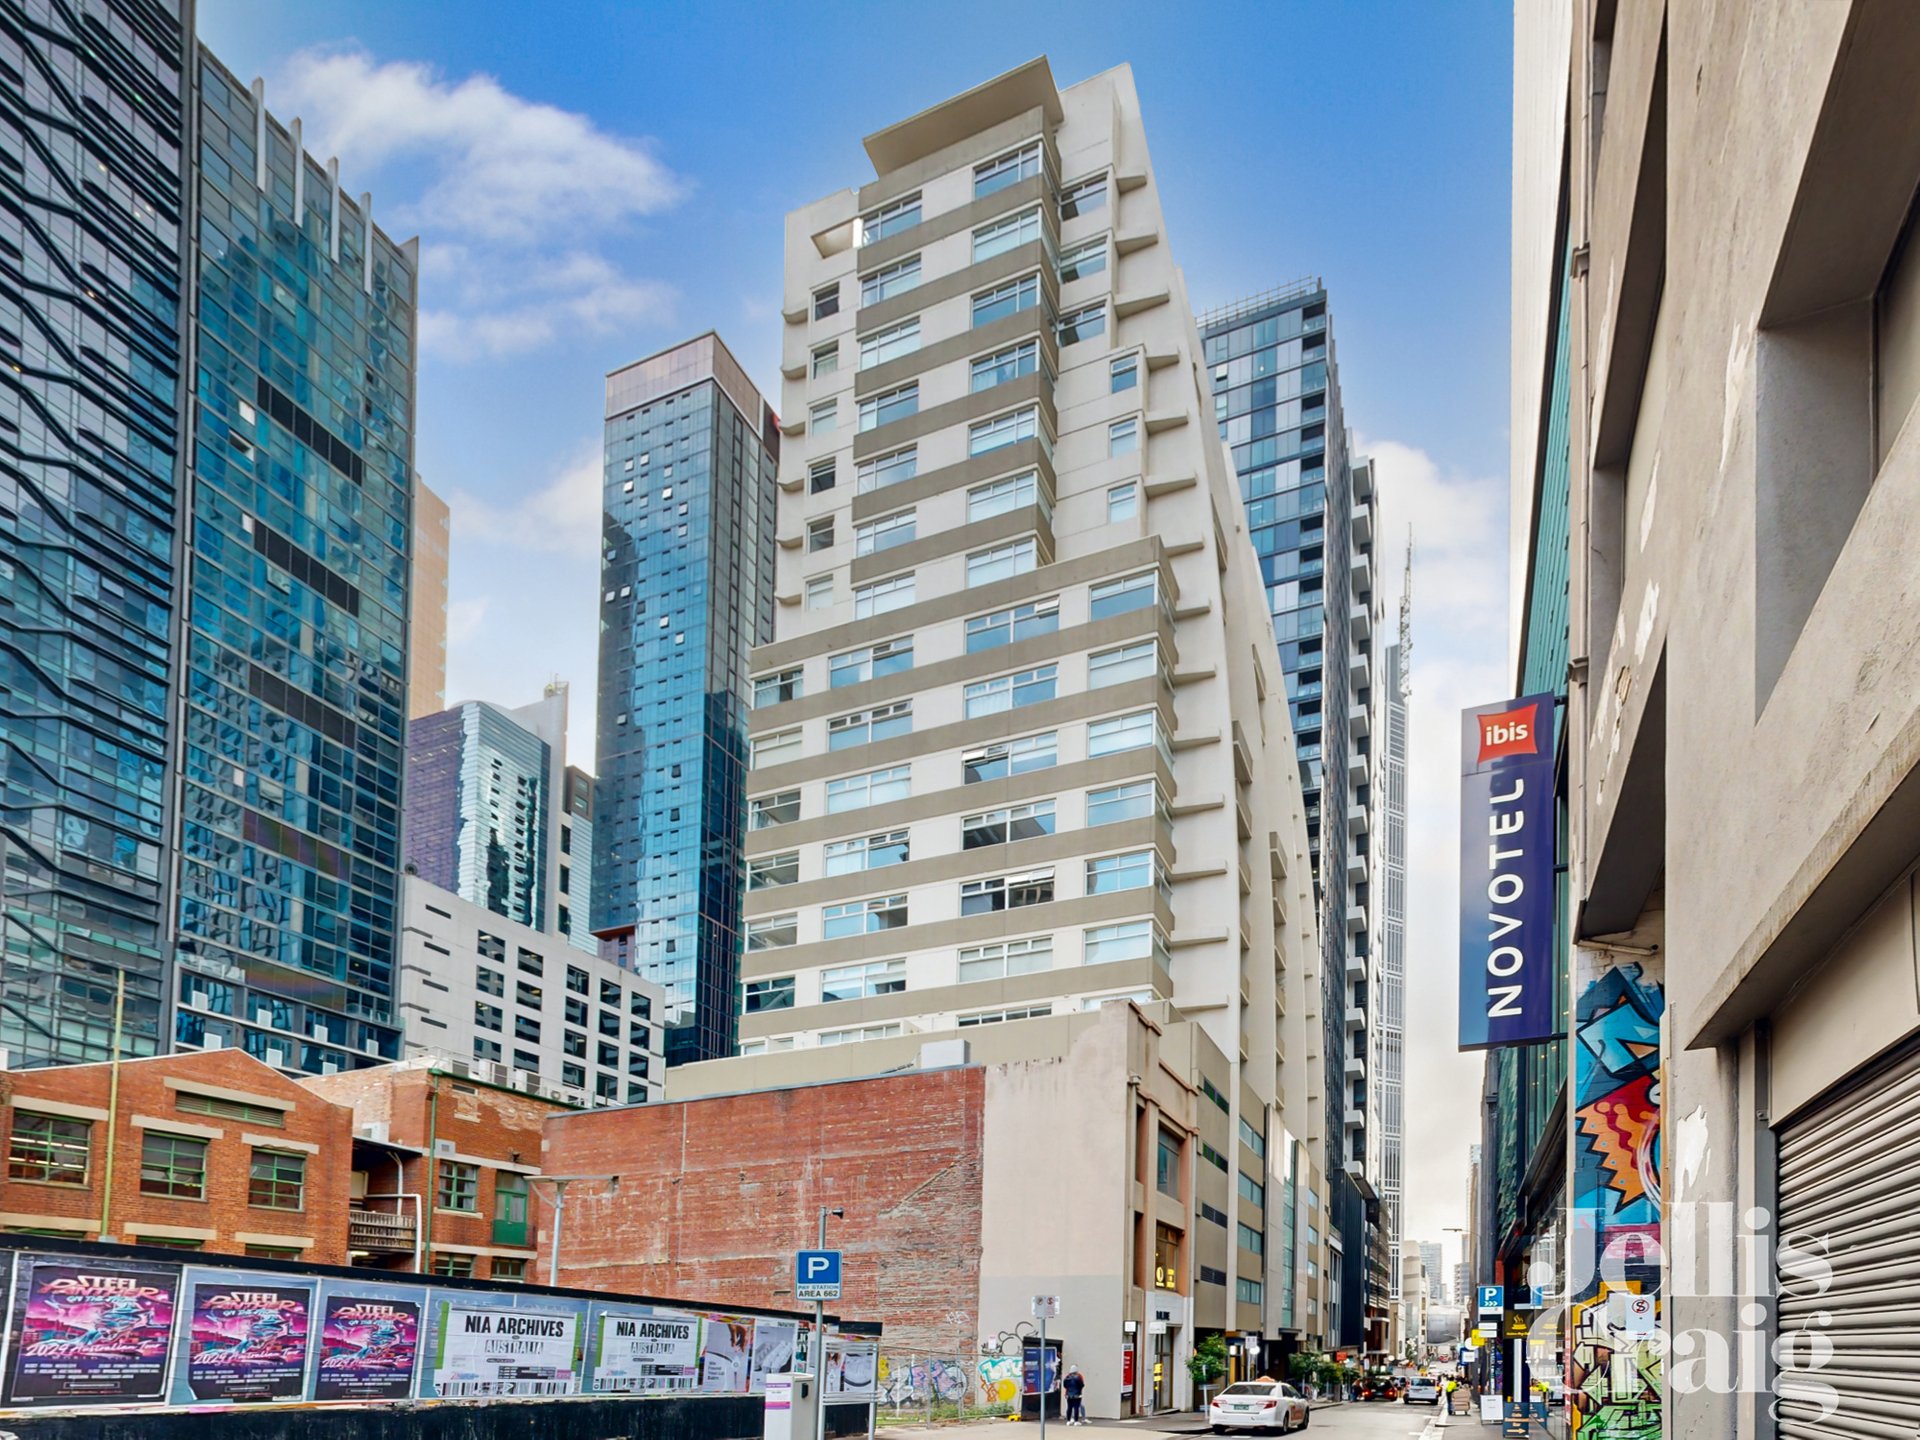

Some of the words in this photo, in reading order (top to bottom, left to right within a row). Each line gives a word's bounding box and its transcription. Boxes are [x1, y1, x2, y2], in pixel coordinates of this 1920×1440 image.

[1485, 722, 1529, 747] ibis
[1487, 777, 1525, 1018] NOVOTEL
[808, 1257, 829, 1279] P
[1485, 1288, 1497, 1301] P
[465, 1315, 491, 1334] NIA
[496, 1316, 564, 1338] ARCHIVES
[616, 1321, 636, 1337] NIA
[640, 1322, 690, 1340] ARCHIVES
[484, 1338, 545, 1355] AUSTRALIA
[631, 1341, 676, 1355] AUSTRALIA
